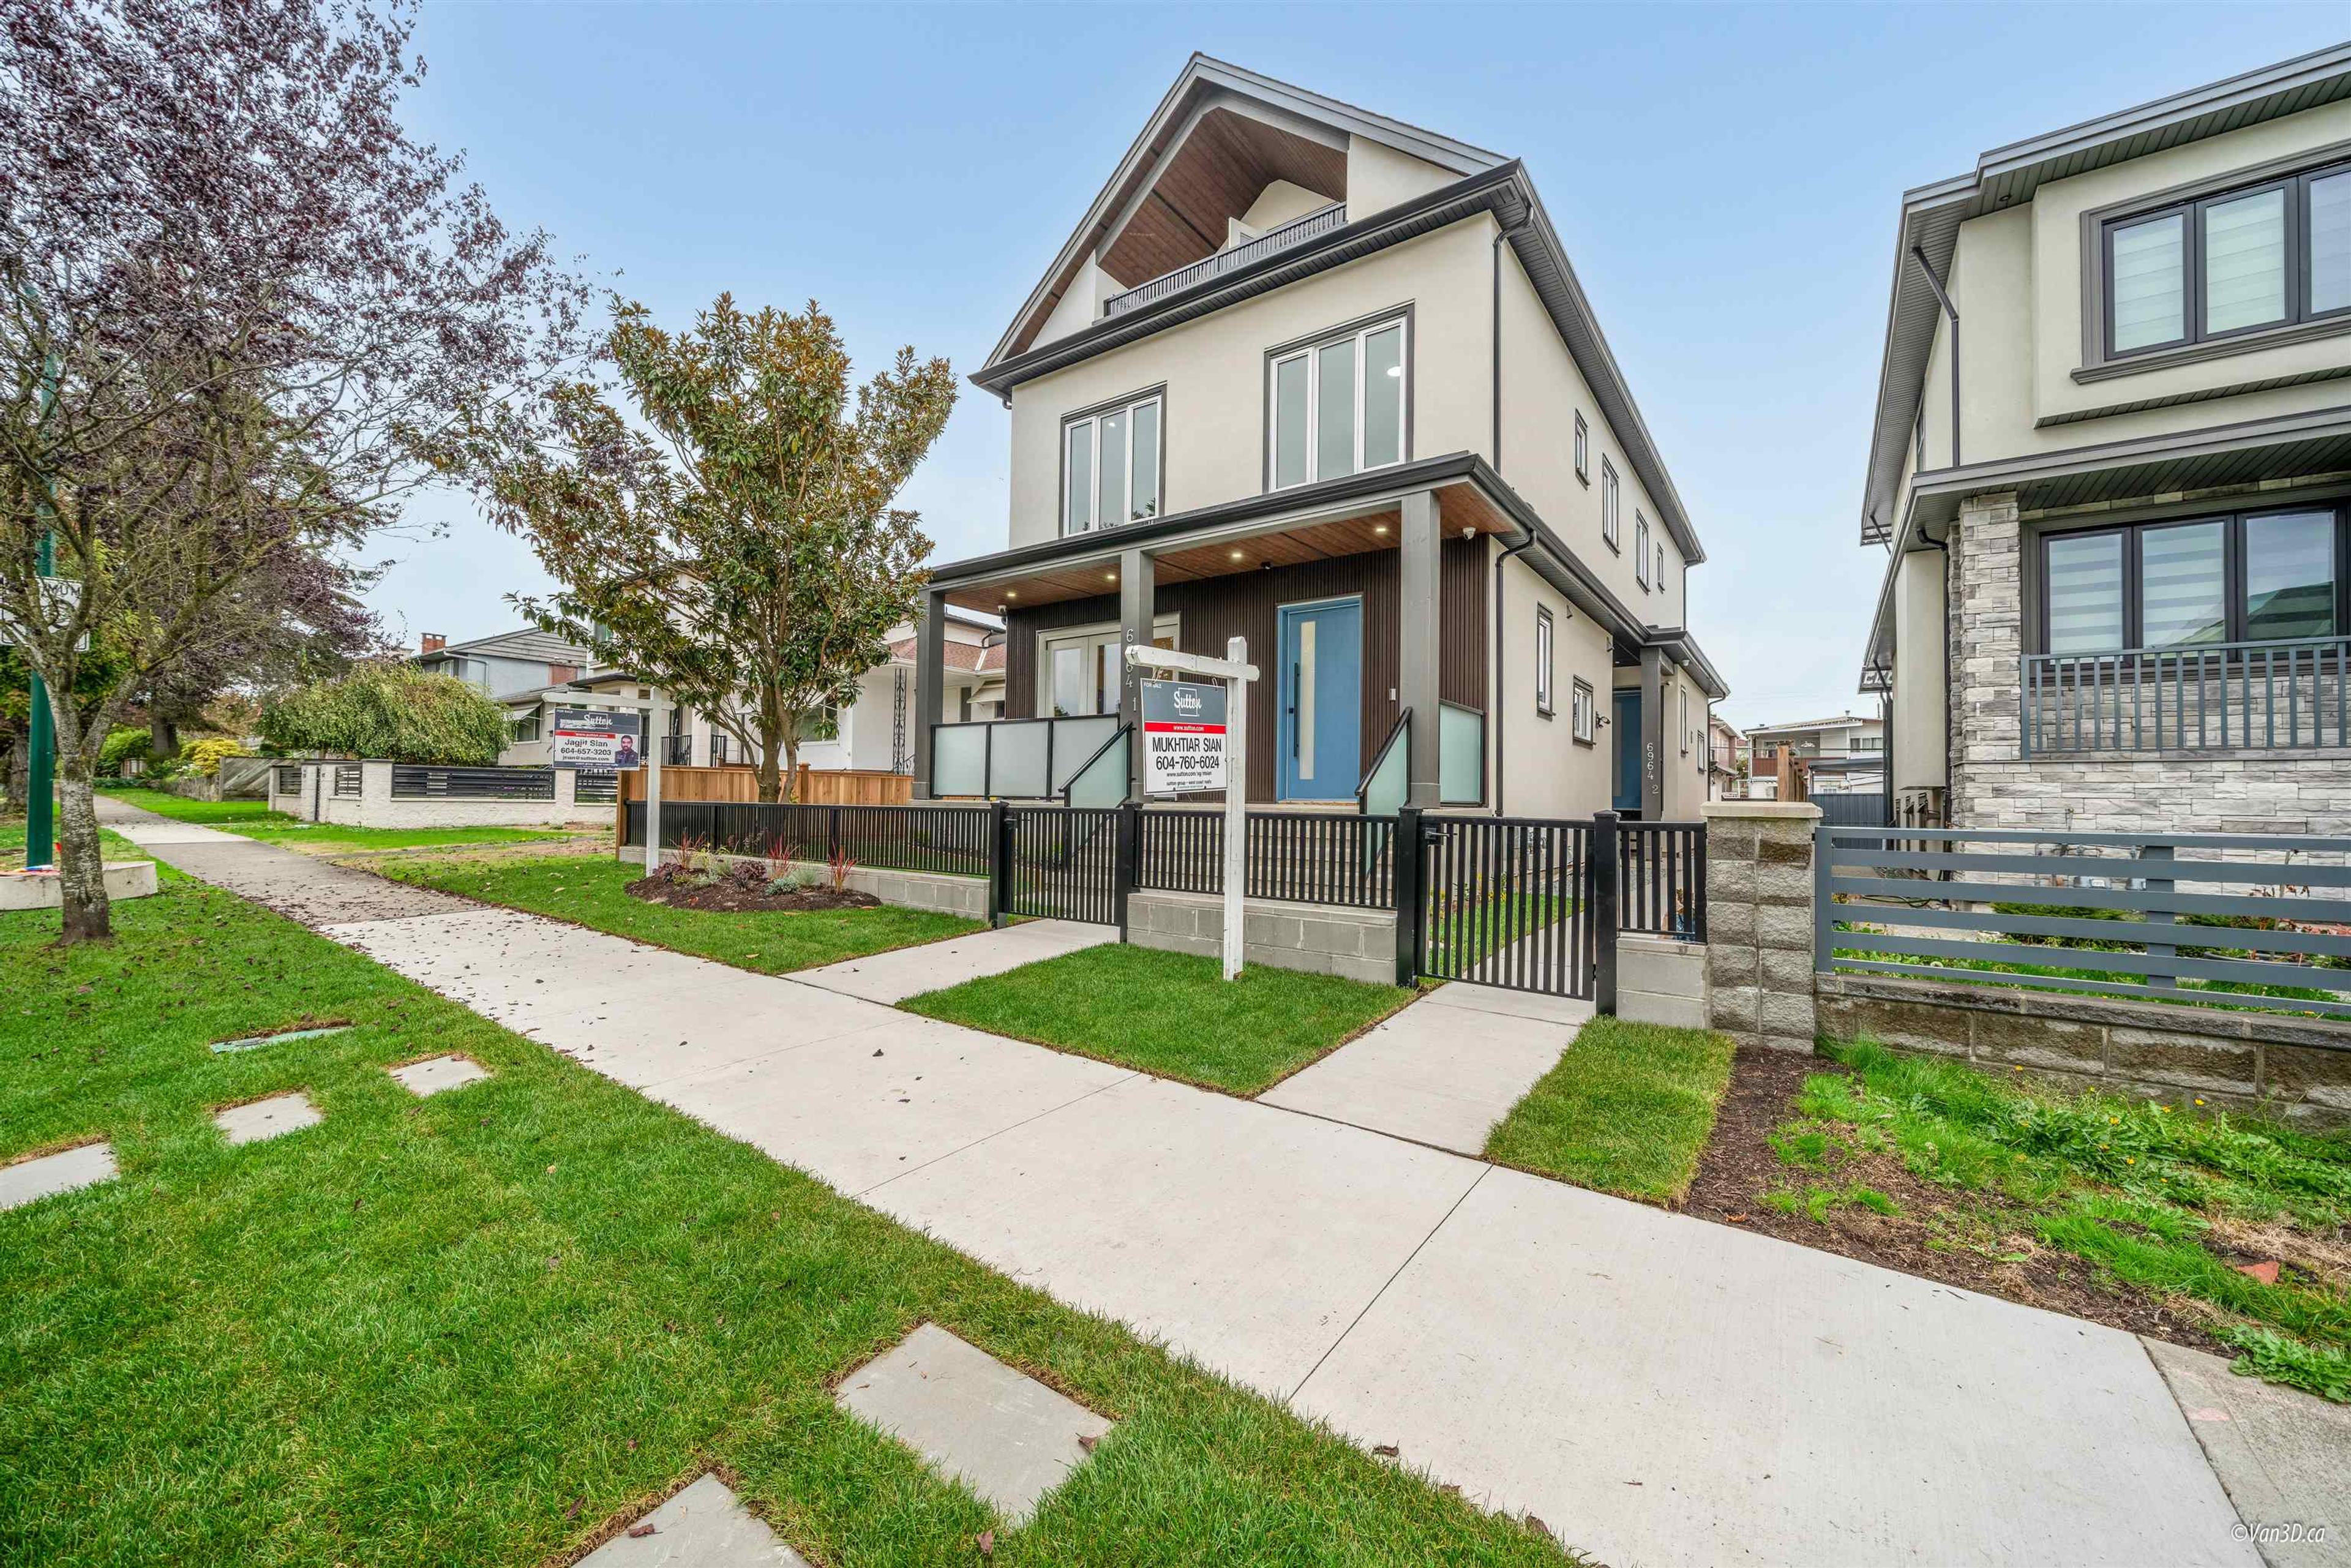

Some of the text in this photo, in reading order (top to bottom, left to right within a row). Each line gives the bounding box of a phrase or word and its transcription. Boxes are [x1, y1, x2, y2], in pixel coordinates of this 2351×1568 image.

[1174, 691, 1202, 709] Sutton
[583, 714, 613, 726] Sutton
[565, 739, 588, 748] Jagjit
[1152, 737, 1221, 752] MUKHTIAR SIAN
[560, 747, 612, 756] 604-657-3203
[1156, 756, 1220, 770] 604-760-6024
[1652, 784, 1659, 794] 2
